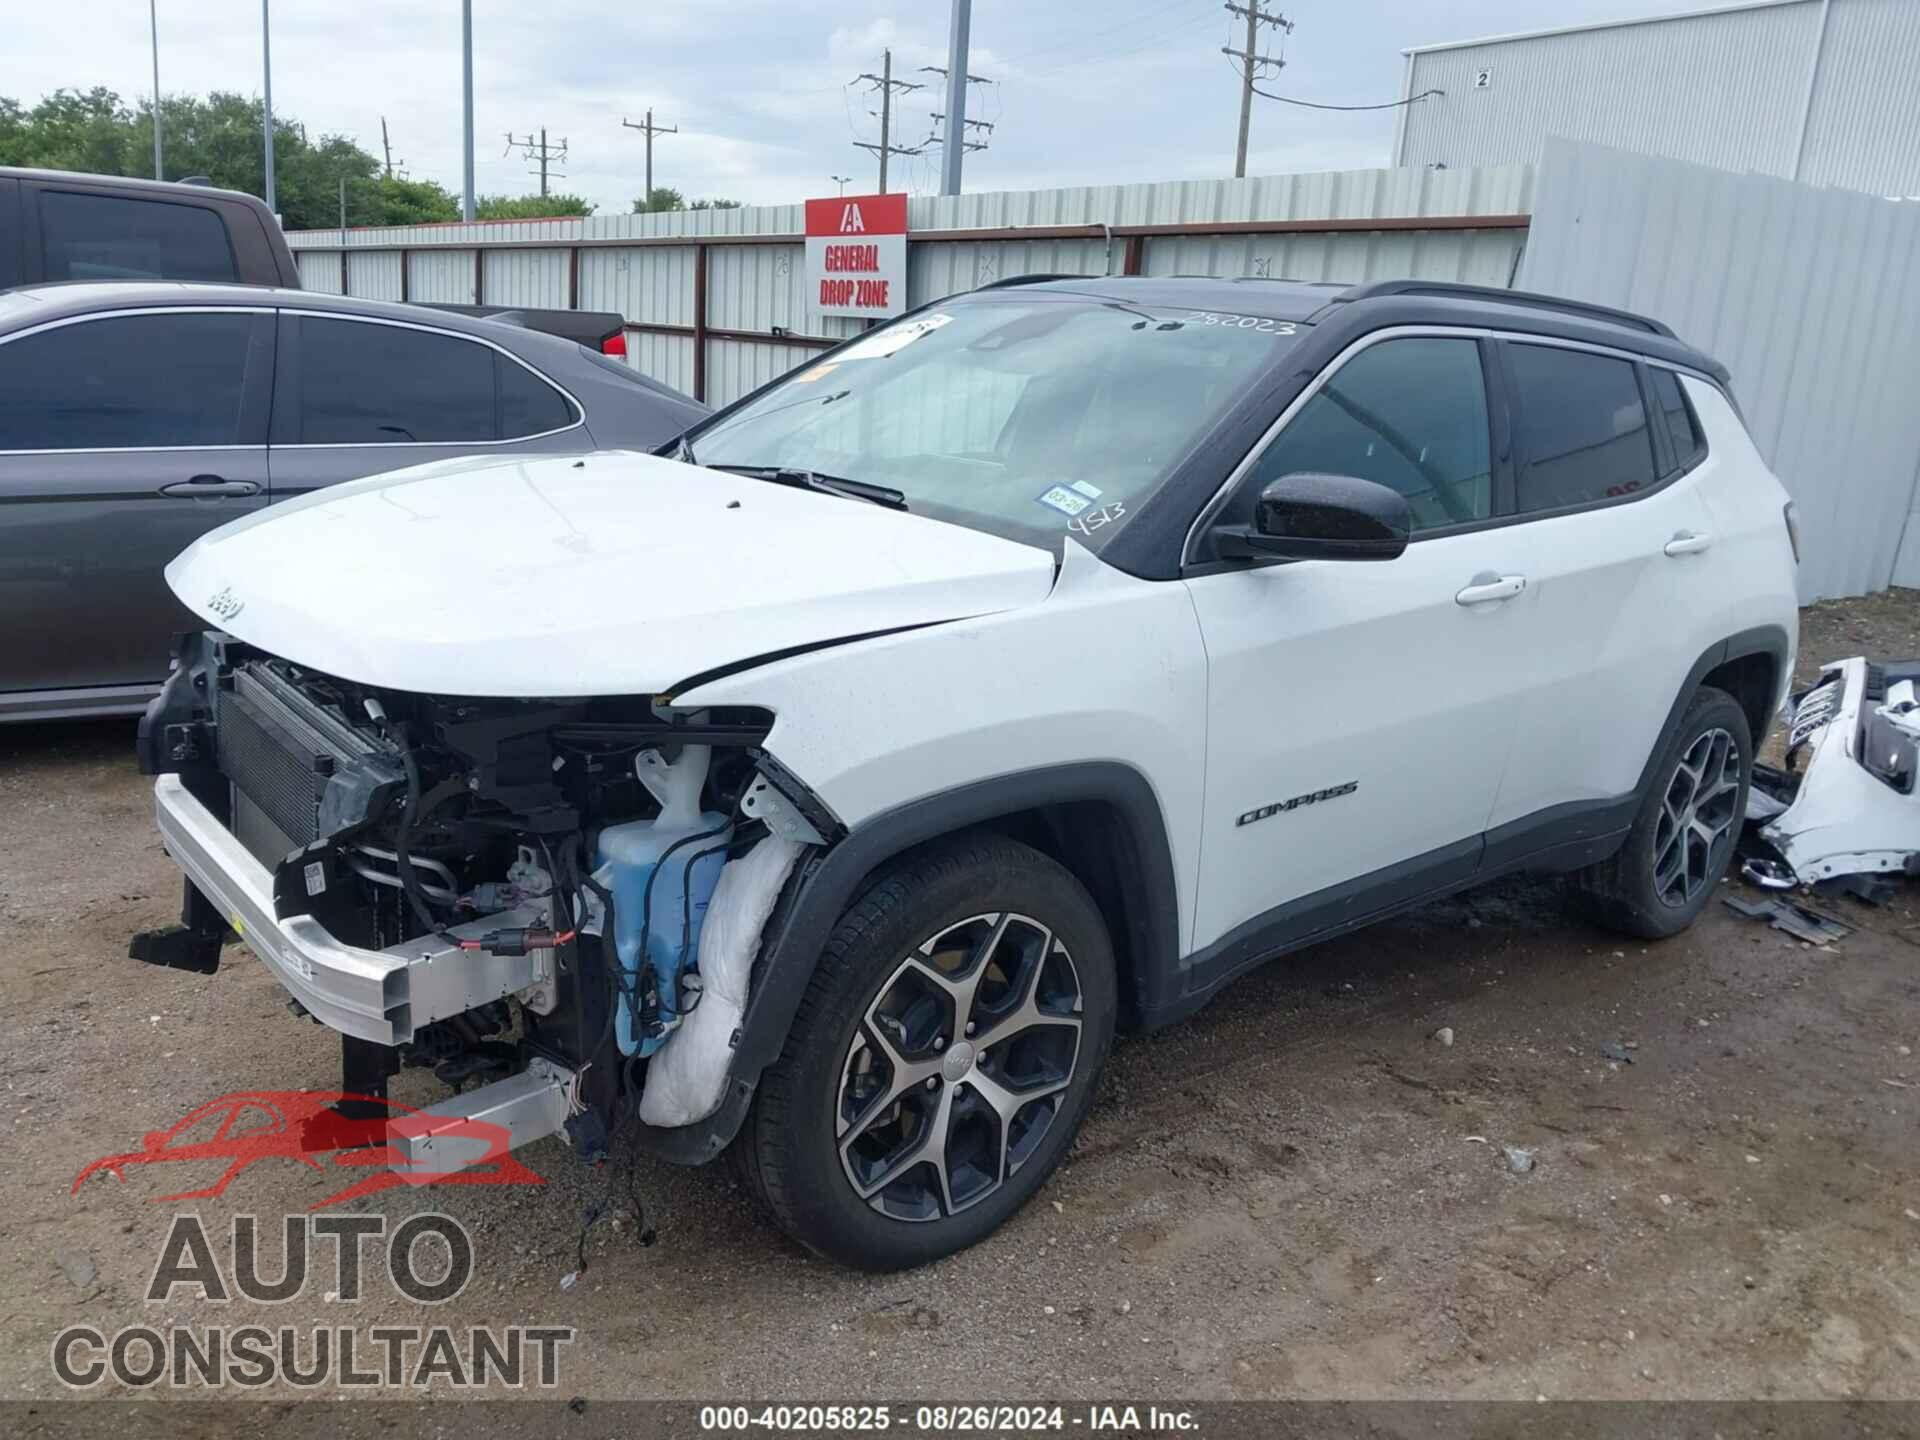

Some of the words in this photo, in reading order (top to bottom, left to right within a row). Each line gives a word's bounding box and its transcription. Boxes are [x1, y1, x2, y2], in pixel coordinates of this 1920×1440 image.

[1478, 73, 1488, 86] 2
[825, 244, 879, 272] GENERAL
[820, 279, 854, 306] DROP
[855, 280, 889, 308] ZONE
[1235, 780, 1359, 828] COMPASS
